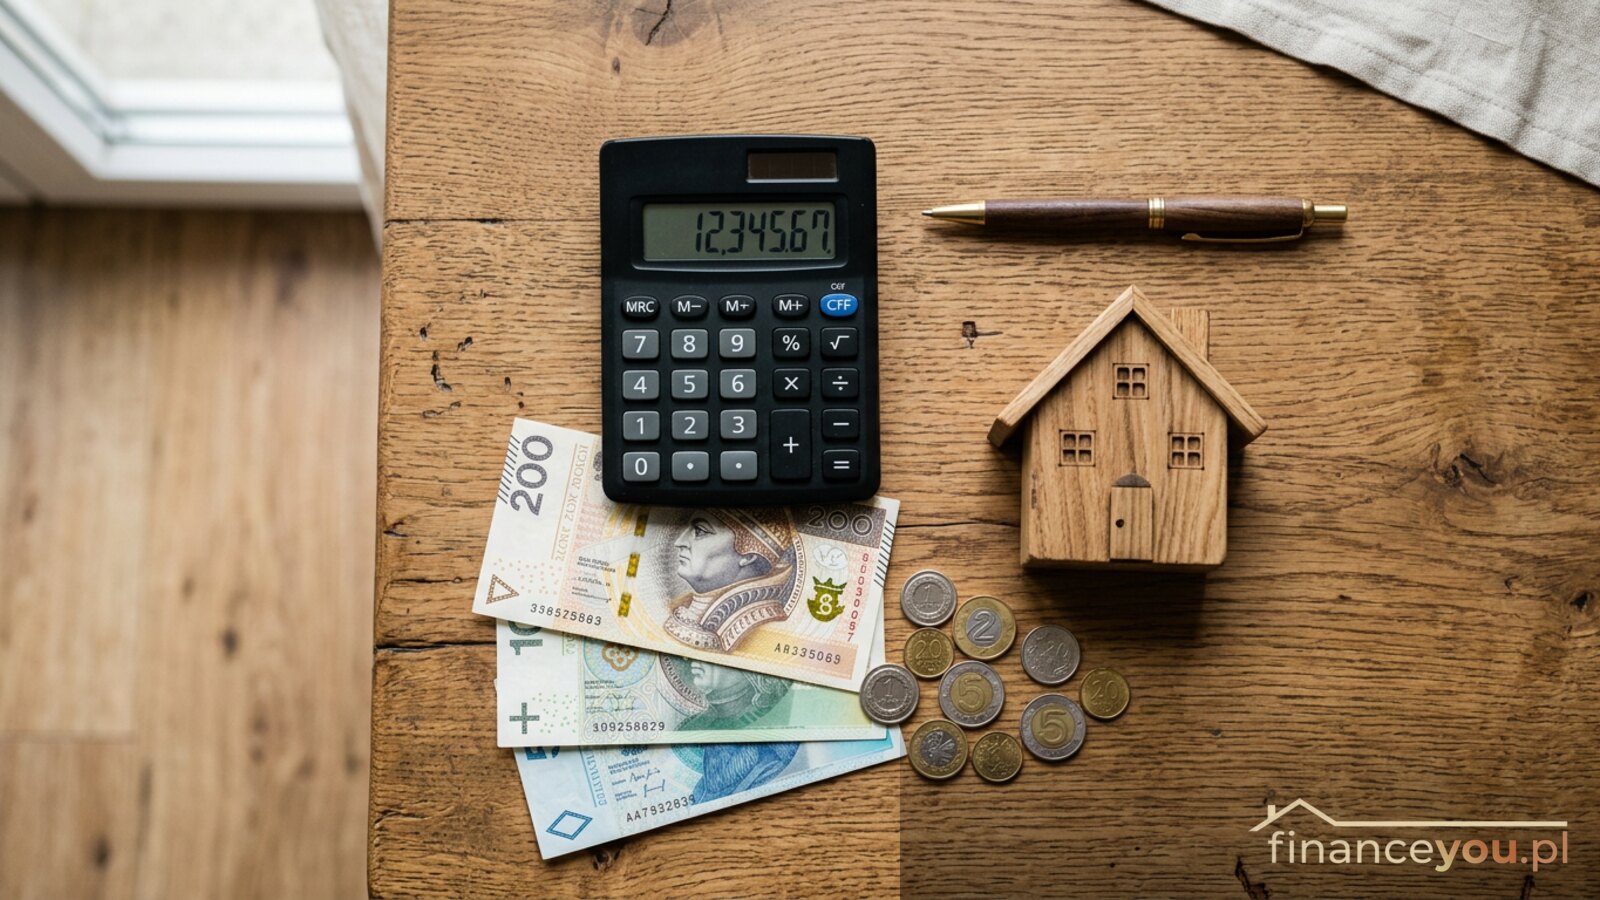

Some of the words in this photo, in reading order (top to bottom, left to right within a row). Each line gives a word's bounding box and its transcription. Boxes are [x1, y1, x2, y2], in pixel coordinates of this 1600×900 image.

[627, 301, 655, 313] MRC
[826, 299, 852, 311] CFF
[634, 336, 647, 353] 7
[683, 335, 696, 352] 8
[731, 335, 744, 352] 9
[633, 376, 647, 394] 4
[684, 375, 696, 393] 5
[731, 375, 744, 392] 6
[636, 417, 644, 435] 1
[684, 417, 696, 434] 2
[732, 416, 745, 433] 3
[634, 458, 648, 475] 0
[510, 435, 553, 516] 200
[806, 506, 873, 538] 200
[967, 610, 995, 642] 2
[914, 638, 942, 660] 20
[958, 673, 985, 713] 5
[1038, 709, 1069, 743] 5
